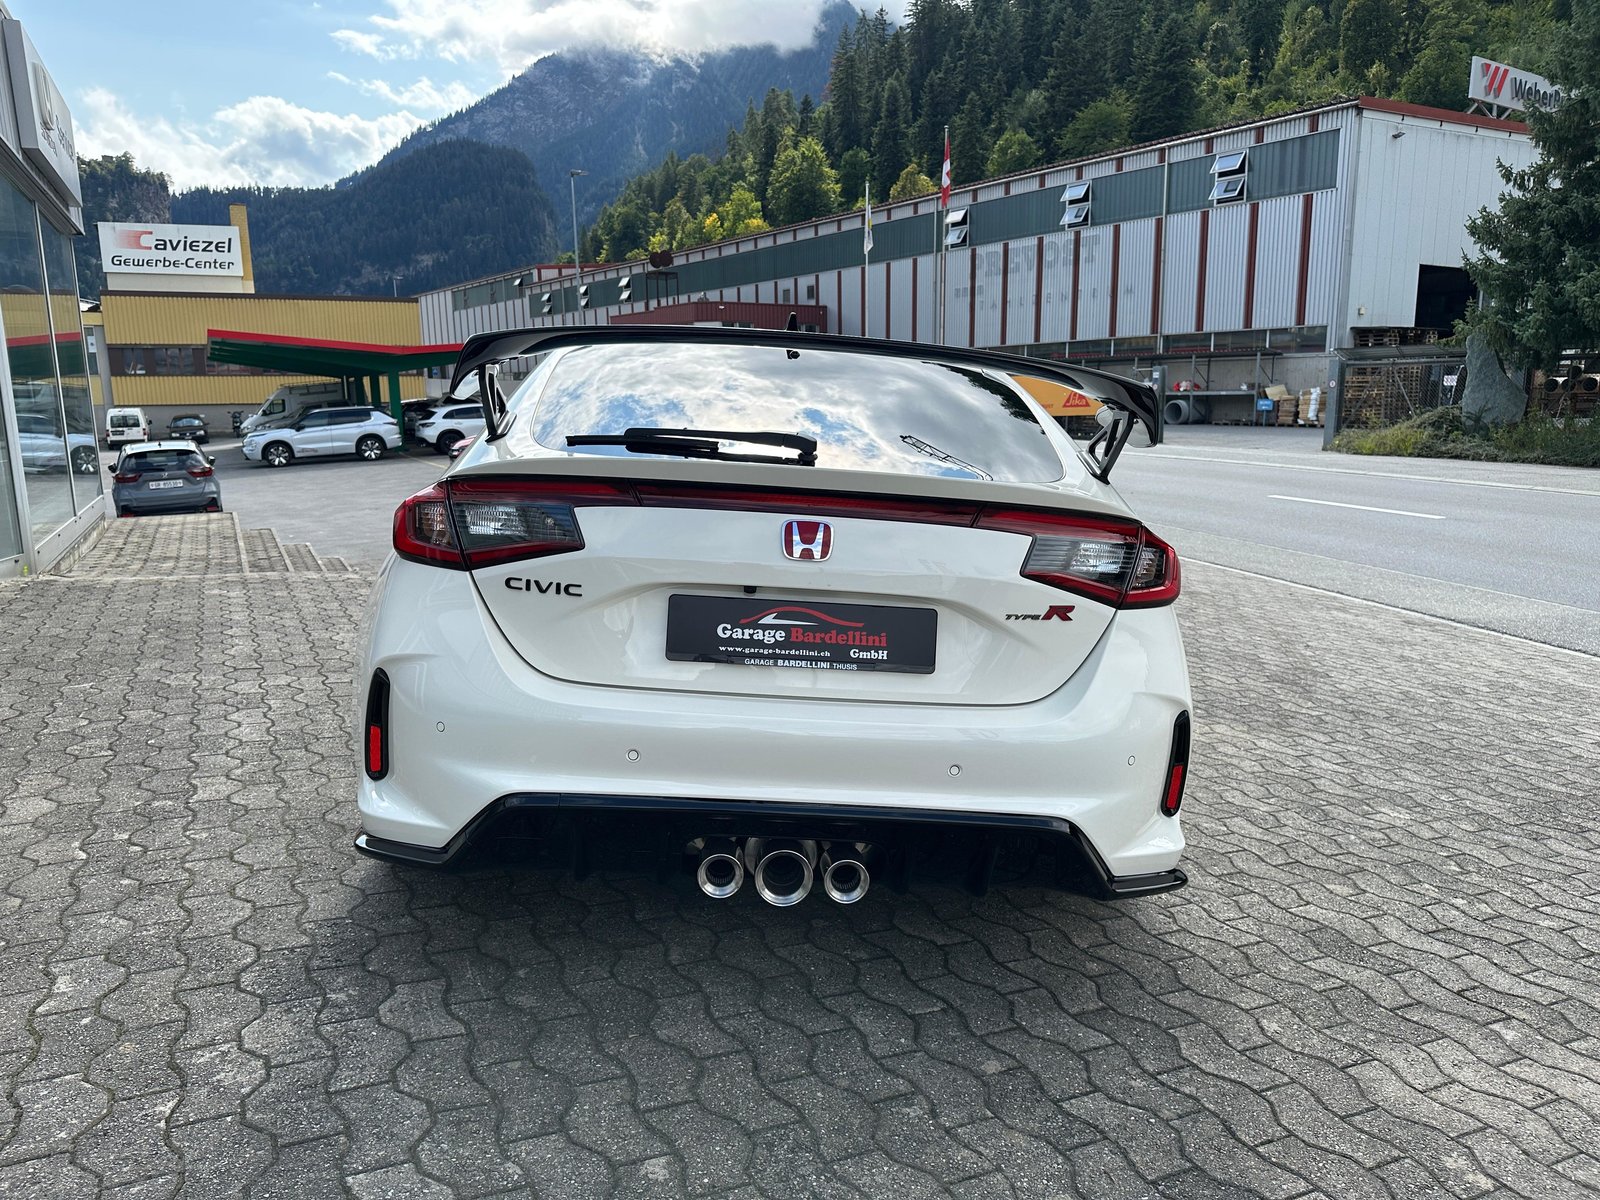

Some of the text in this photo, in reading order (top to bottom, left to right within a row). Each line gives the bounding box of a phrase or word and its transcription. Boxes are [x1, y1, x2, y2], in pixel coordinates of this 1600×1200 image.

[1512, 77, 1563, 104] WeberP
[130, 230, 232, 253] Caviezel
[111, 255, 235, 270] Gewerbe-Center
[1066, 391, 1086, 406] Sika
[504, 576, 583, 597] CIVIC
[1005, 605, 1075, 621] TYPE R
[716, 623, 888, 647] Garage Bardellini
[718, 645, 831, 657] www.garage-bardellini.ch
[849, 649, 888, 660] GmbH
[744, 658, 858, 671] GARAGE BARDELLINI THUSIS
